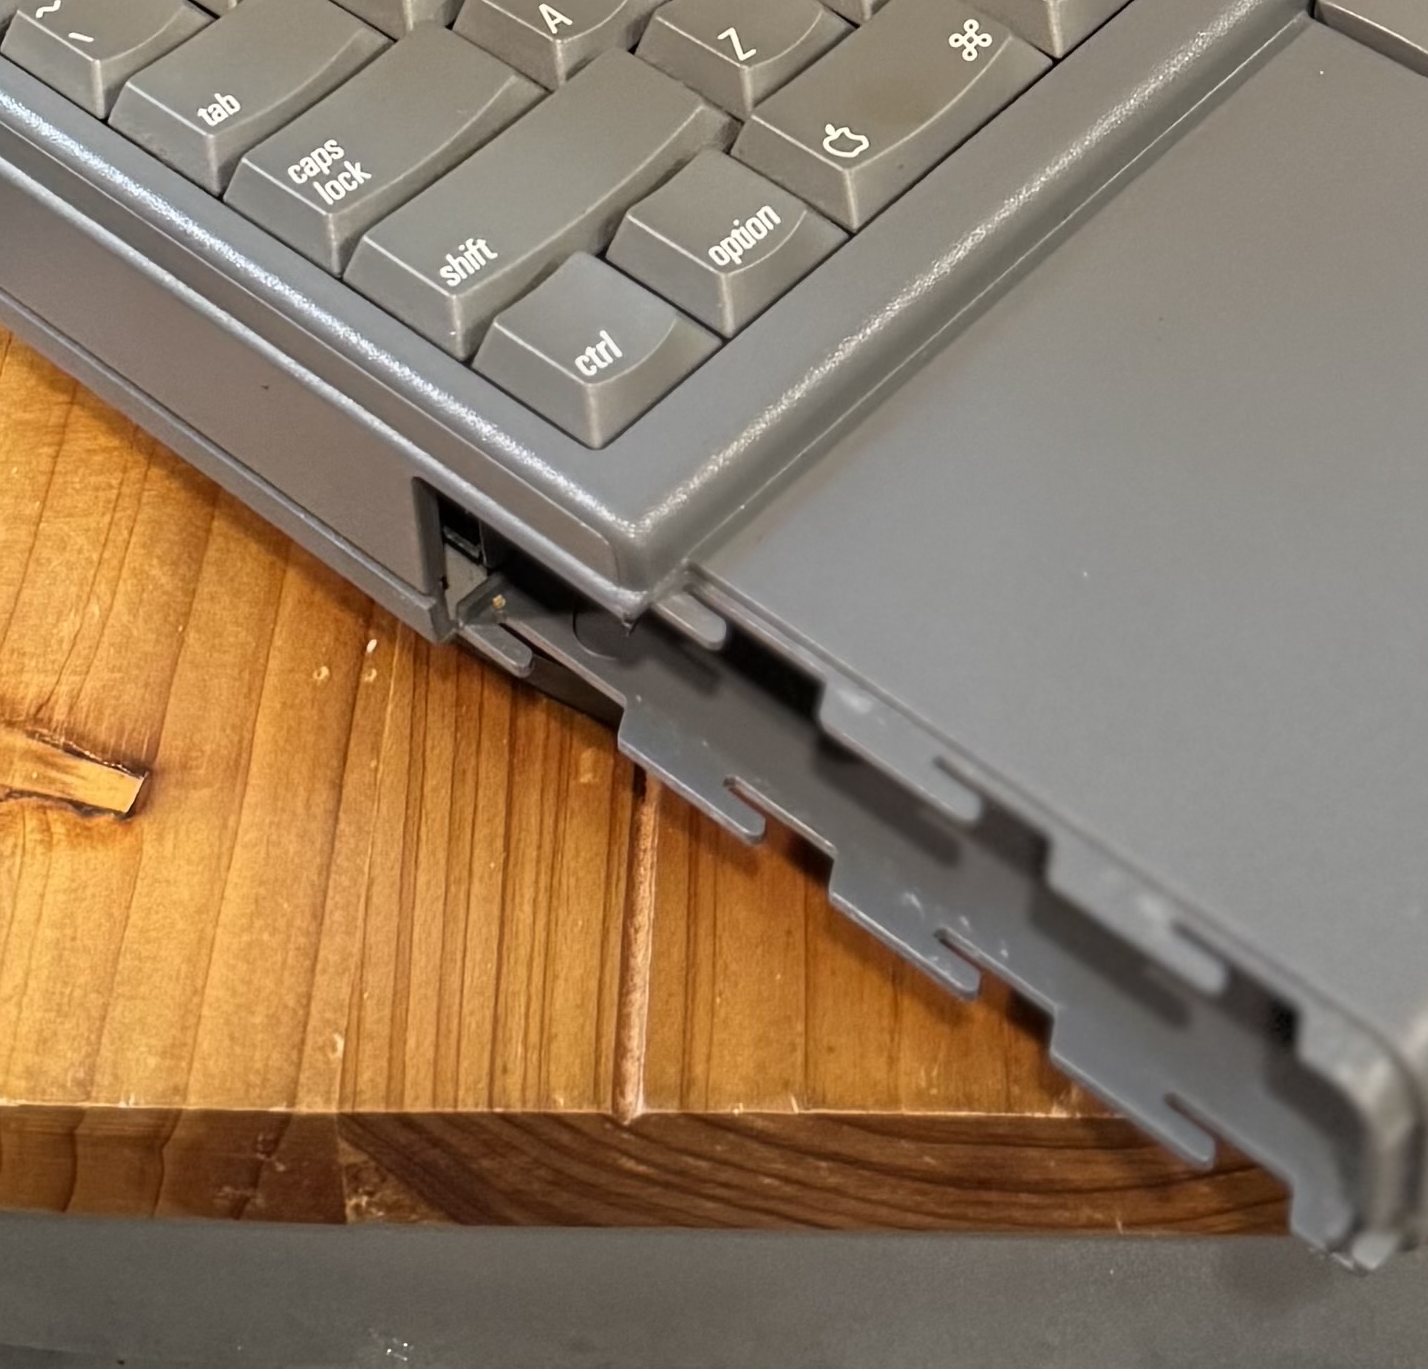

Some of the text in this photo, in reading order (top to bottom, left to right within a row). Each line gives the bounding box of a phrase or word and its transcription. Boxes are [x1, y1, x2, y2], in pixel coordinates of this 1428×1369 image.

[537, 2, 573, 35] A
[717, 26, 757, 62] Z
[196, 91, 241, 128] tab
[286, 138, 345, 185] caps
[312, 159, 372, 206] lock
[707, 204, 782, 268] option
[438, 237, 499, 288] shift
[573, 329, 624, 377] ctrl
